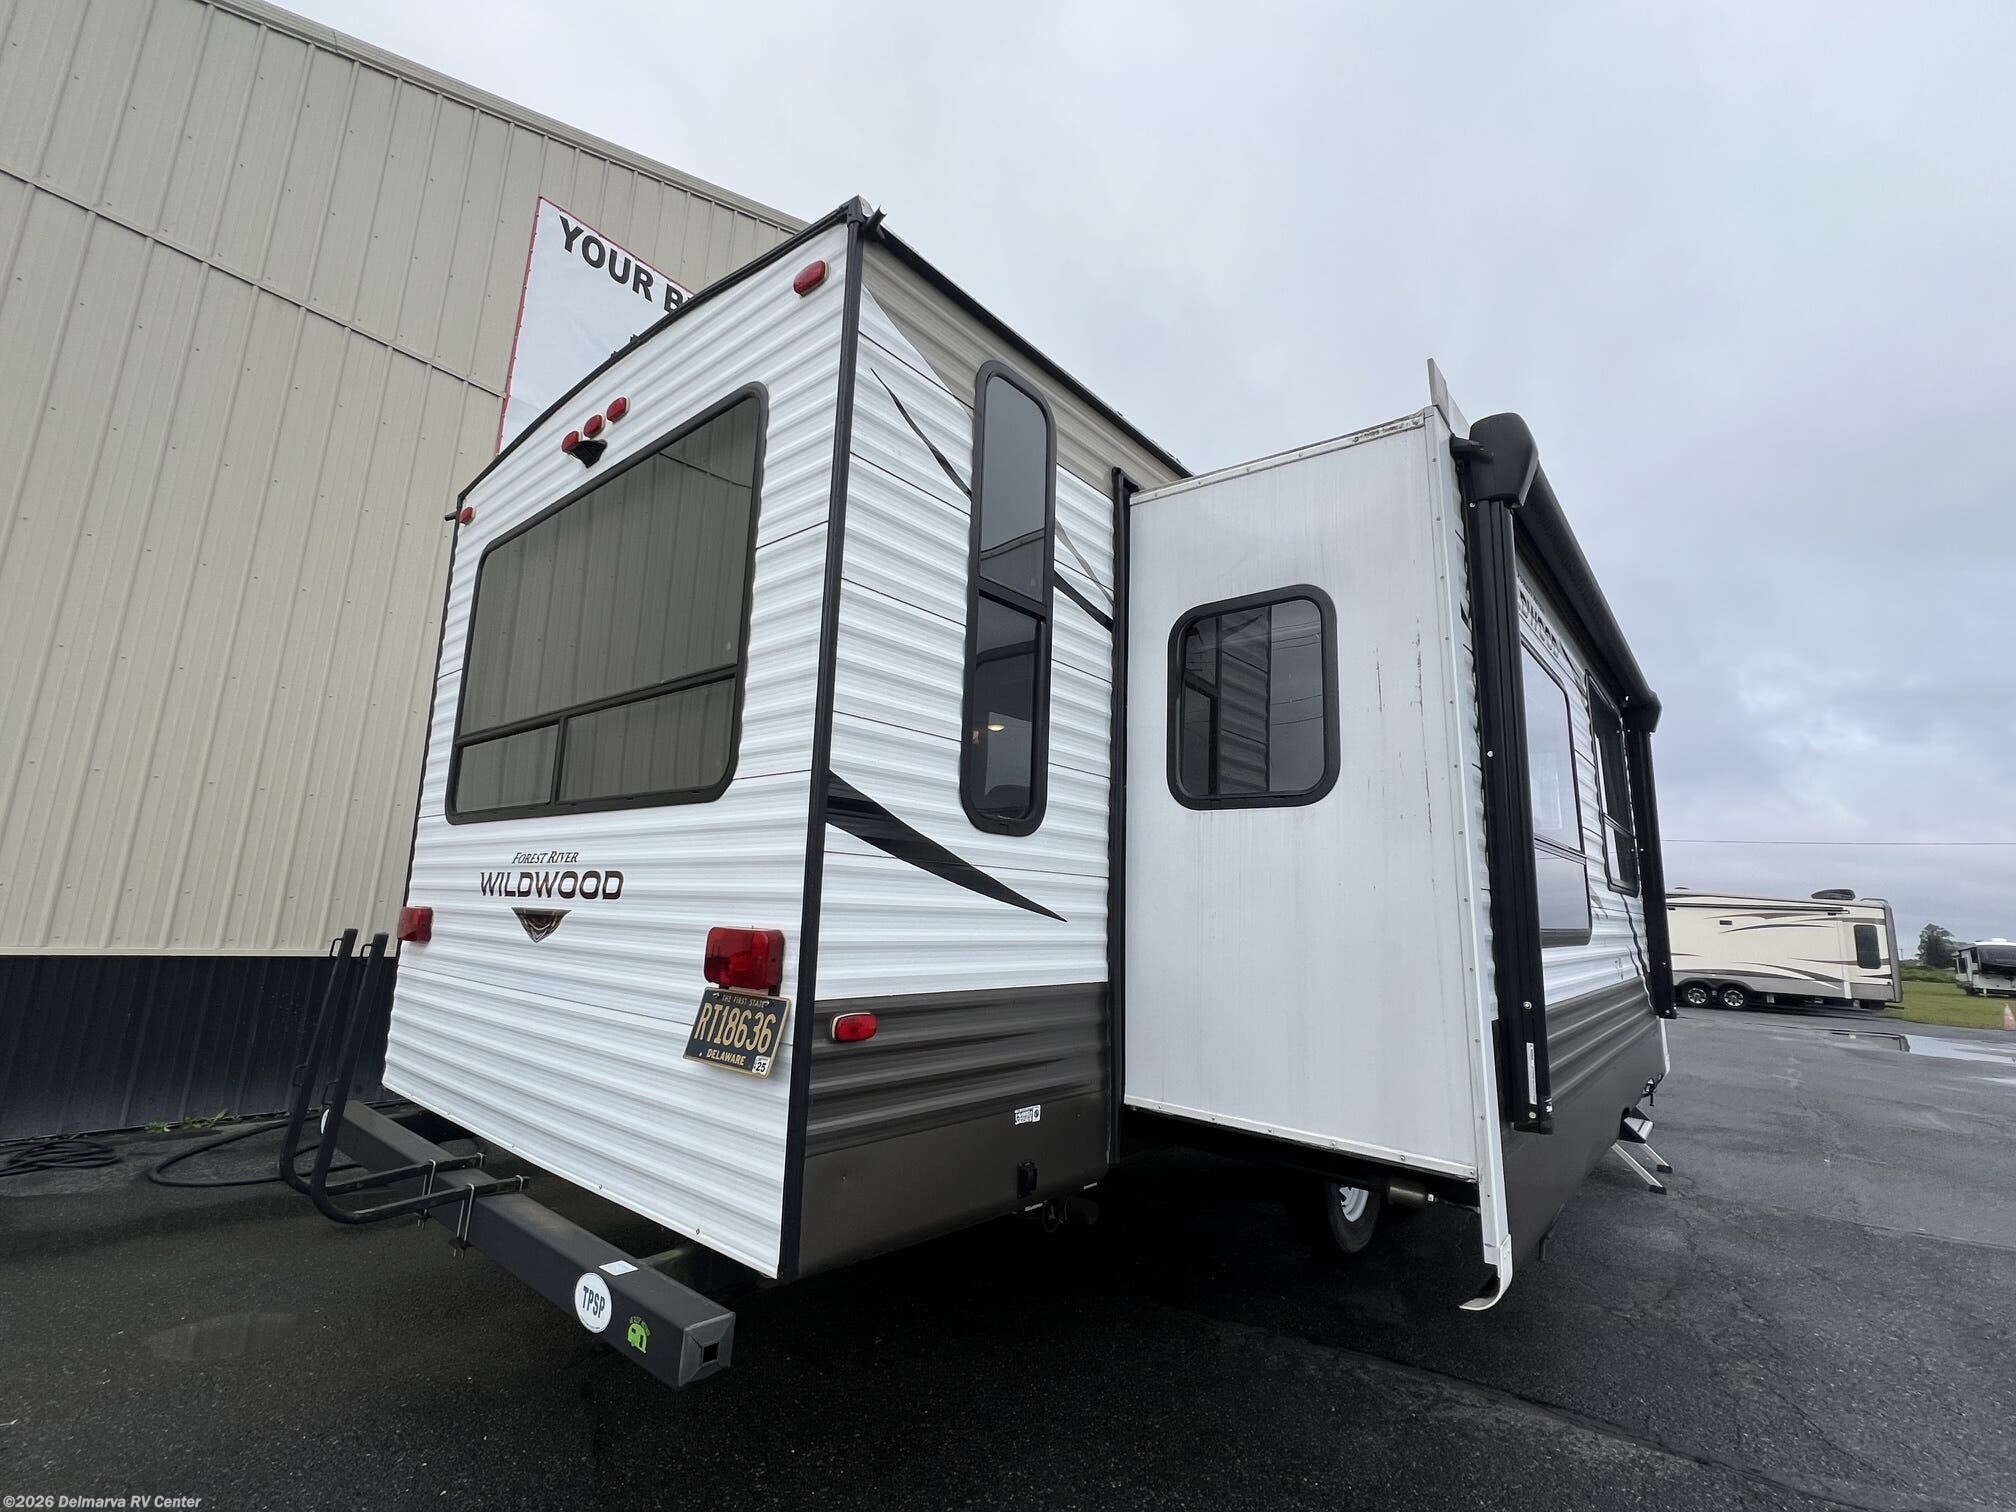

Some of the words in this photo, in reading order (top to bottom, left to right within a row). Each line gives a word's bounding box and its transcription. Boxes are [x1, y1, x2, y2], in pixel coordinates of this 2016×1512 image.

[559, 214, 654, 303] YOUR
[664, 283, 692, 313] B
[511, 851, 549, 864] FOREST
[548, 850, 580, 864] RIVER
[480, 870, 624, 900] WILDWOOD
[733, 996, 748, 1006] FIRST
[693, 1002, 777, 1054] RT18636
[706, 1048, 747, 1066] DELAWARE
[755, 1061, 767, 1073] 25
[582, 1285, 606, 1319] TPSP
